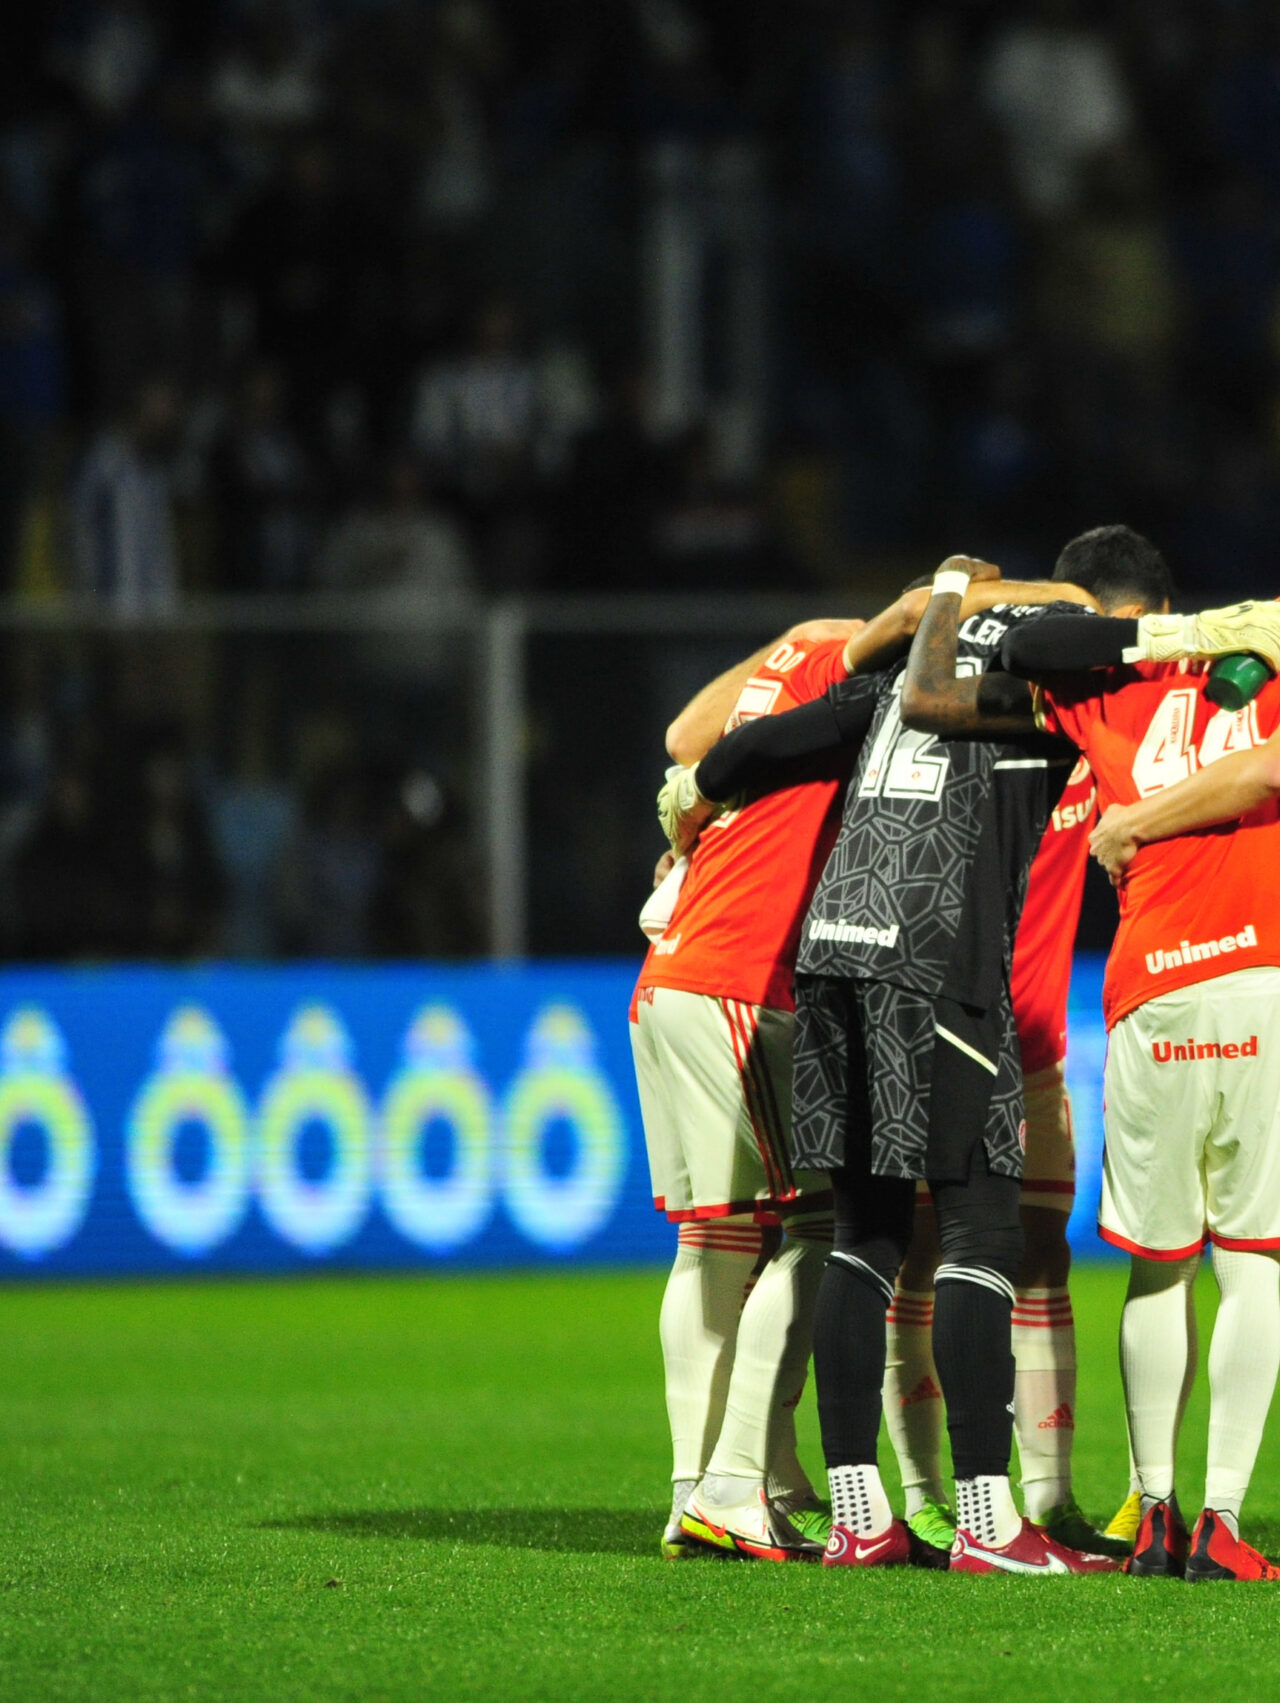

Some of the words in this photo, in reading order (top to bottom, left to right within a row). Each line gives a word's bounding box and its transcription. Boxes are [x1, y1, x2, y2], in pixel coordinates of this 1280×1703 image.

[809, 919, 900, 948] Unimed
[1145, 924, 1258, 975] Unimed
[1151, 1035, 1259, 1064] Unimed
